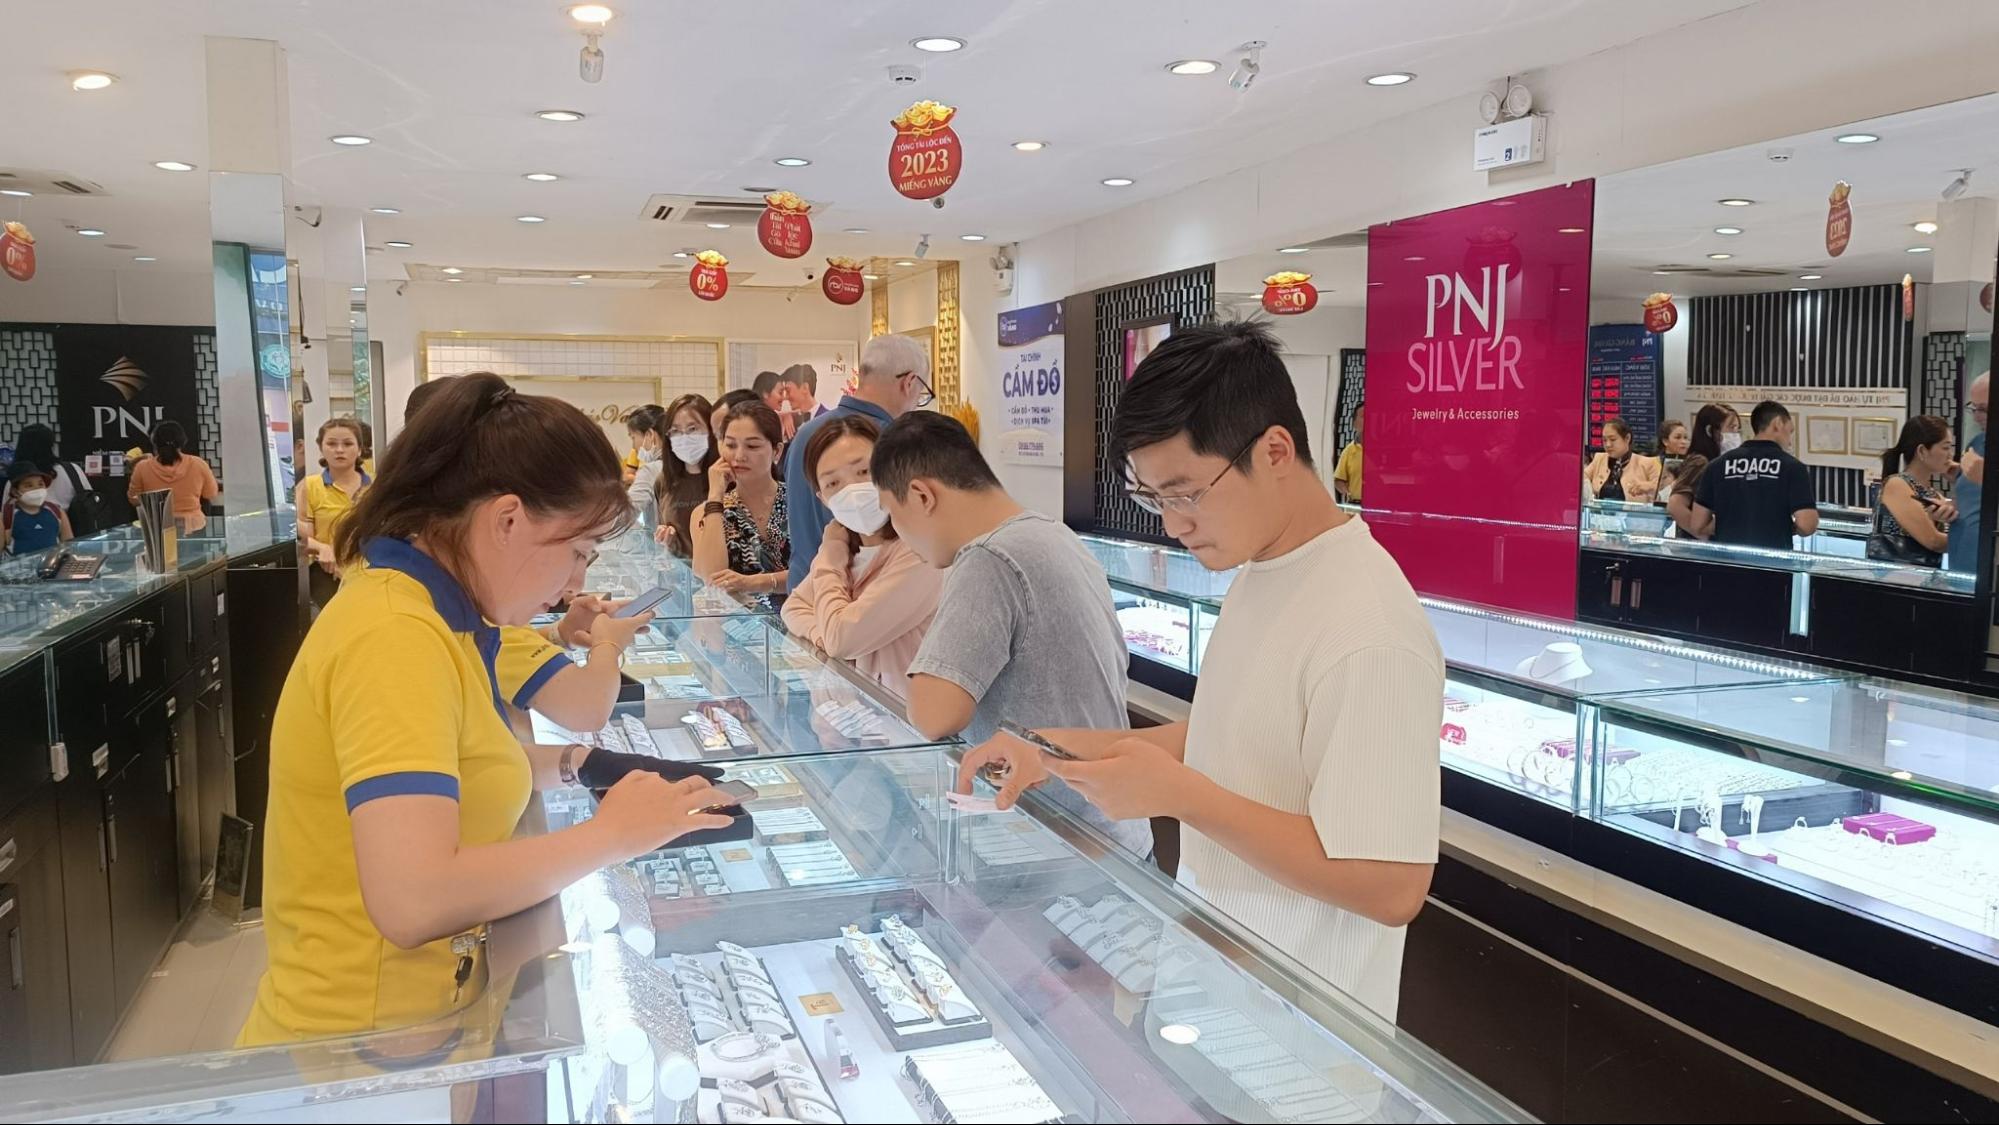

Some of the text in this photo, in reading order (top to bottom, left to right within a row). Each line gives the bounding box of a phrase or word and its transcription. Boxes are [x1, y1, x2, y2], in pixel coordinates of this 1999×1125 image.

[901, 148, 949, 178] 2023
[899, 175, 952, 192] MIẾNG VÀNG
[697, 273, 719, 291] 0%
[1424, 263, 1511, 352] PNJ
[1003, 358, 1061, 398] CẦM ĐỒ
[1406, 335, 1525, 394] SILVER
[1412, 407, 1520, 423] Jewelry & Accessories
